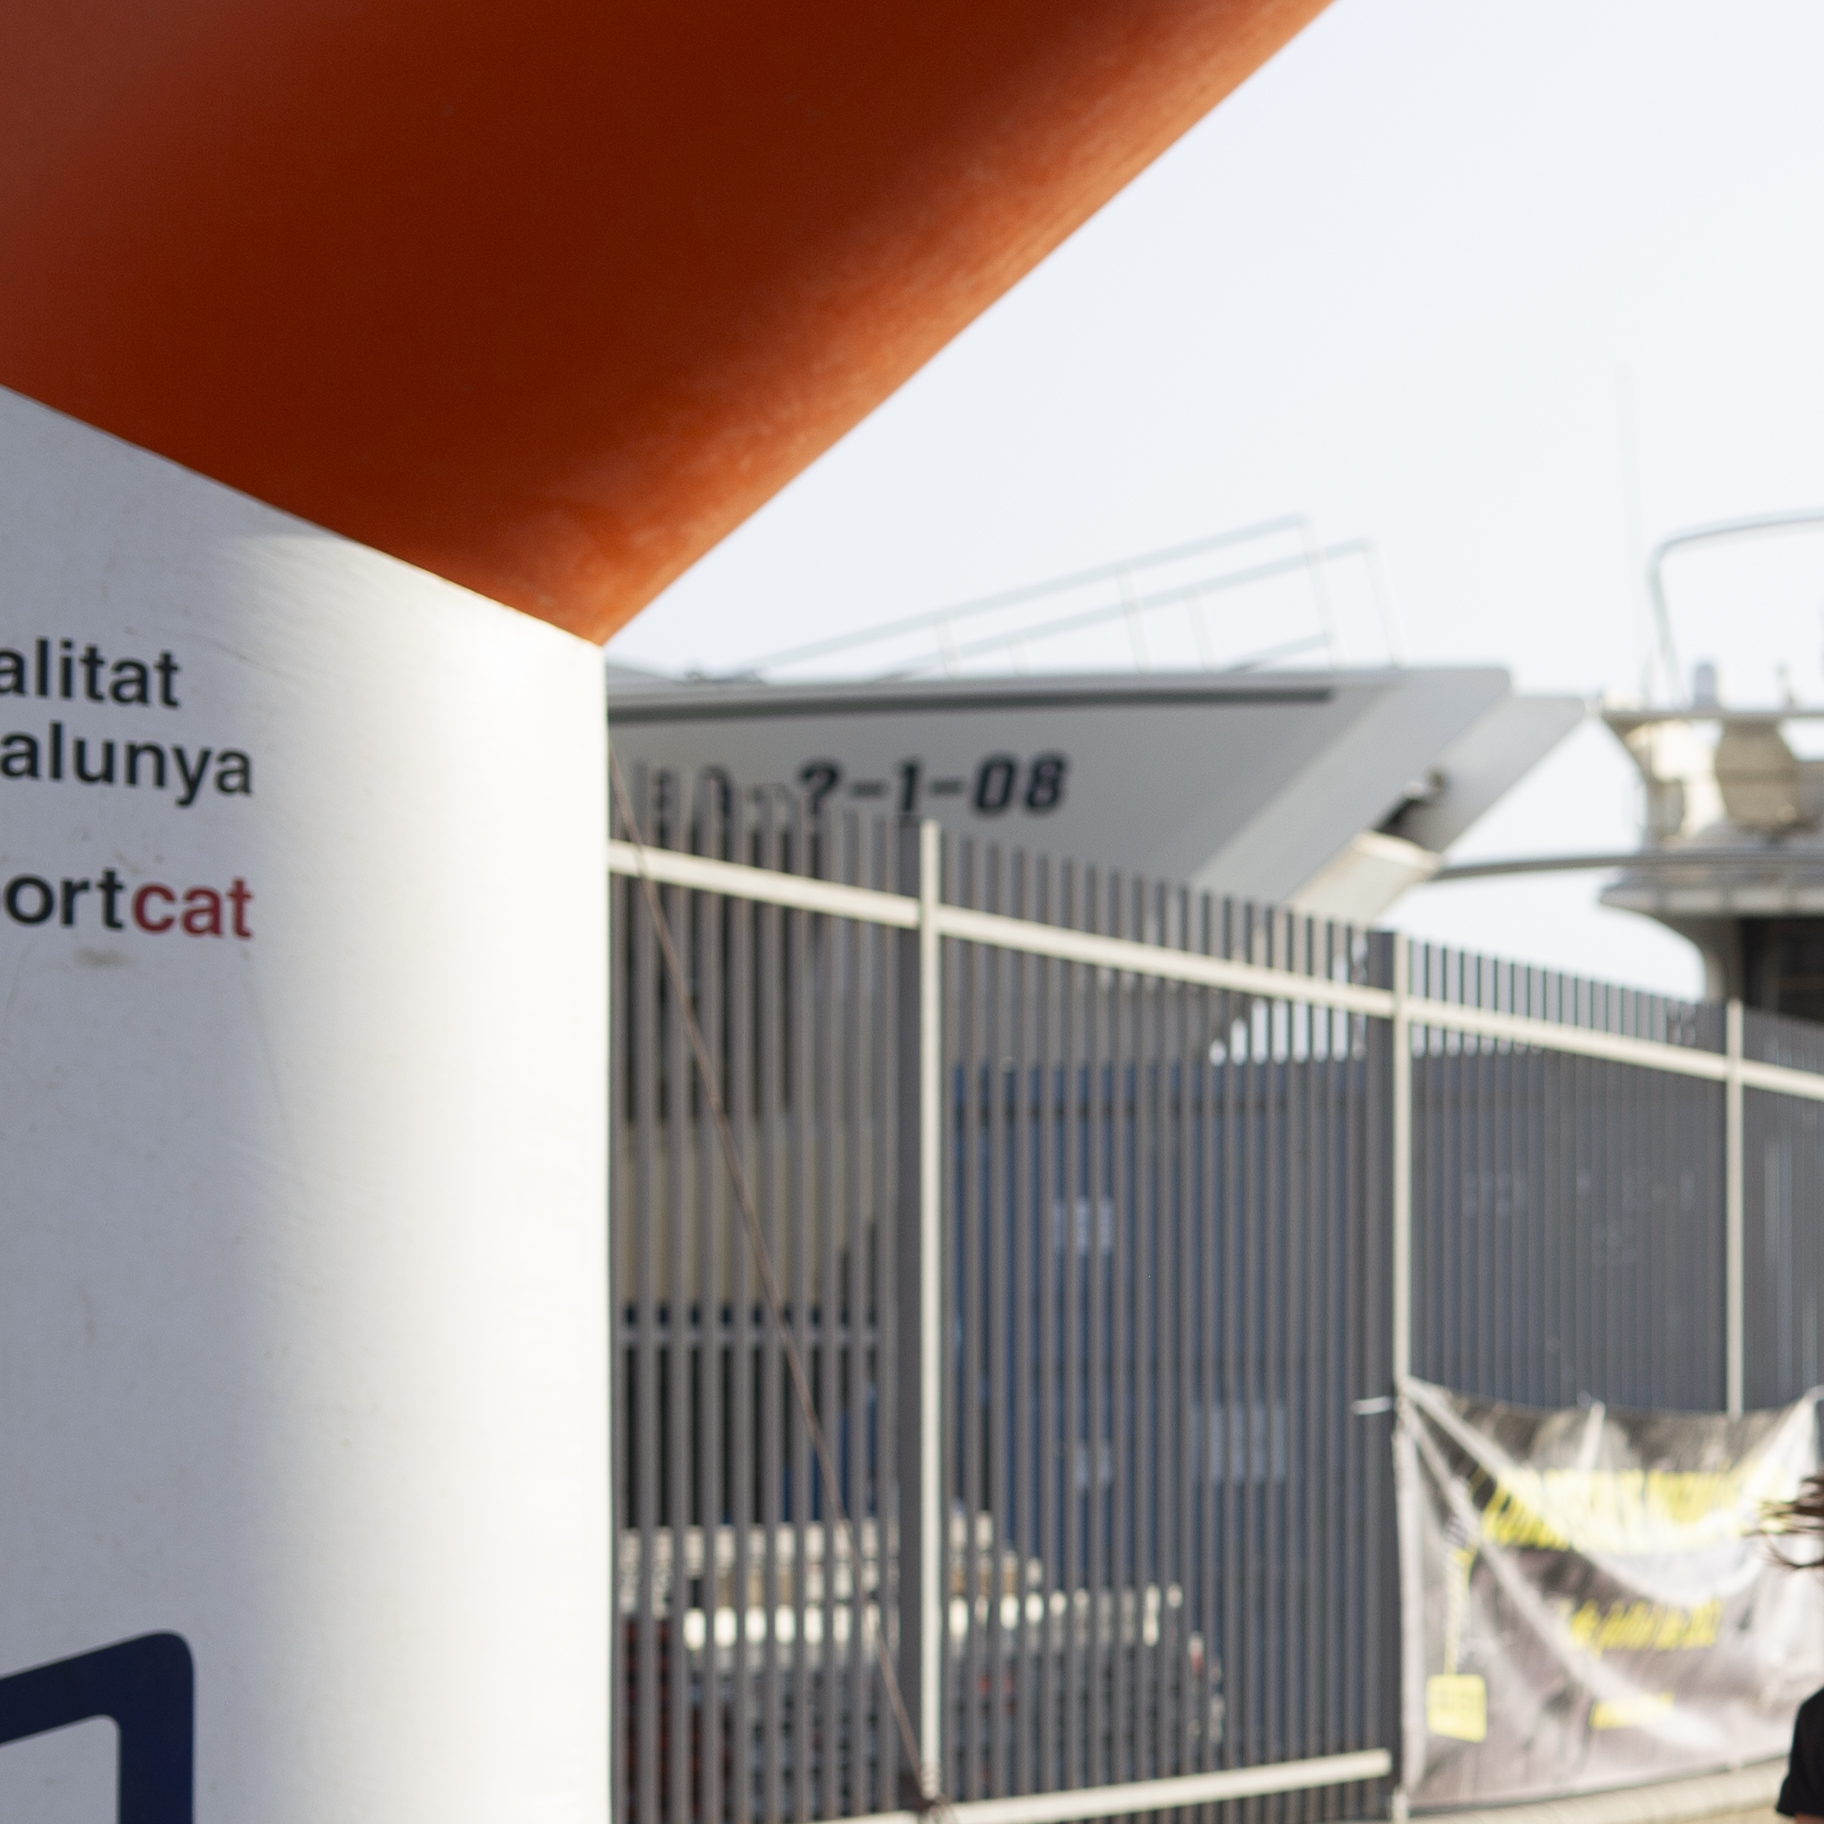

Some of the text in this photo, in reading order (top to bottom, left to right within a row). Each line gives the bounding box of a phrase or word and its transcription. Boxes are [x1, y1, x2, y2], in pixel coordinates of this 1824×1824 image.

[0, 637, 181, 710] alitat
[0, 720, 254, 808] alunya
[3, 867, 254, 940] ortcat
